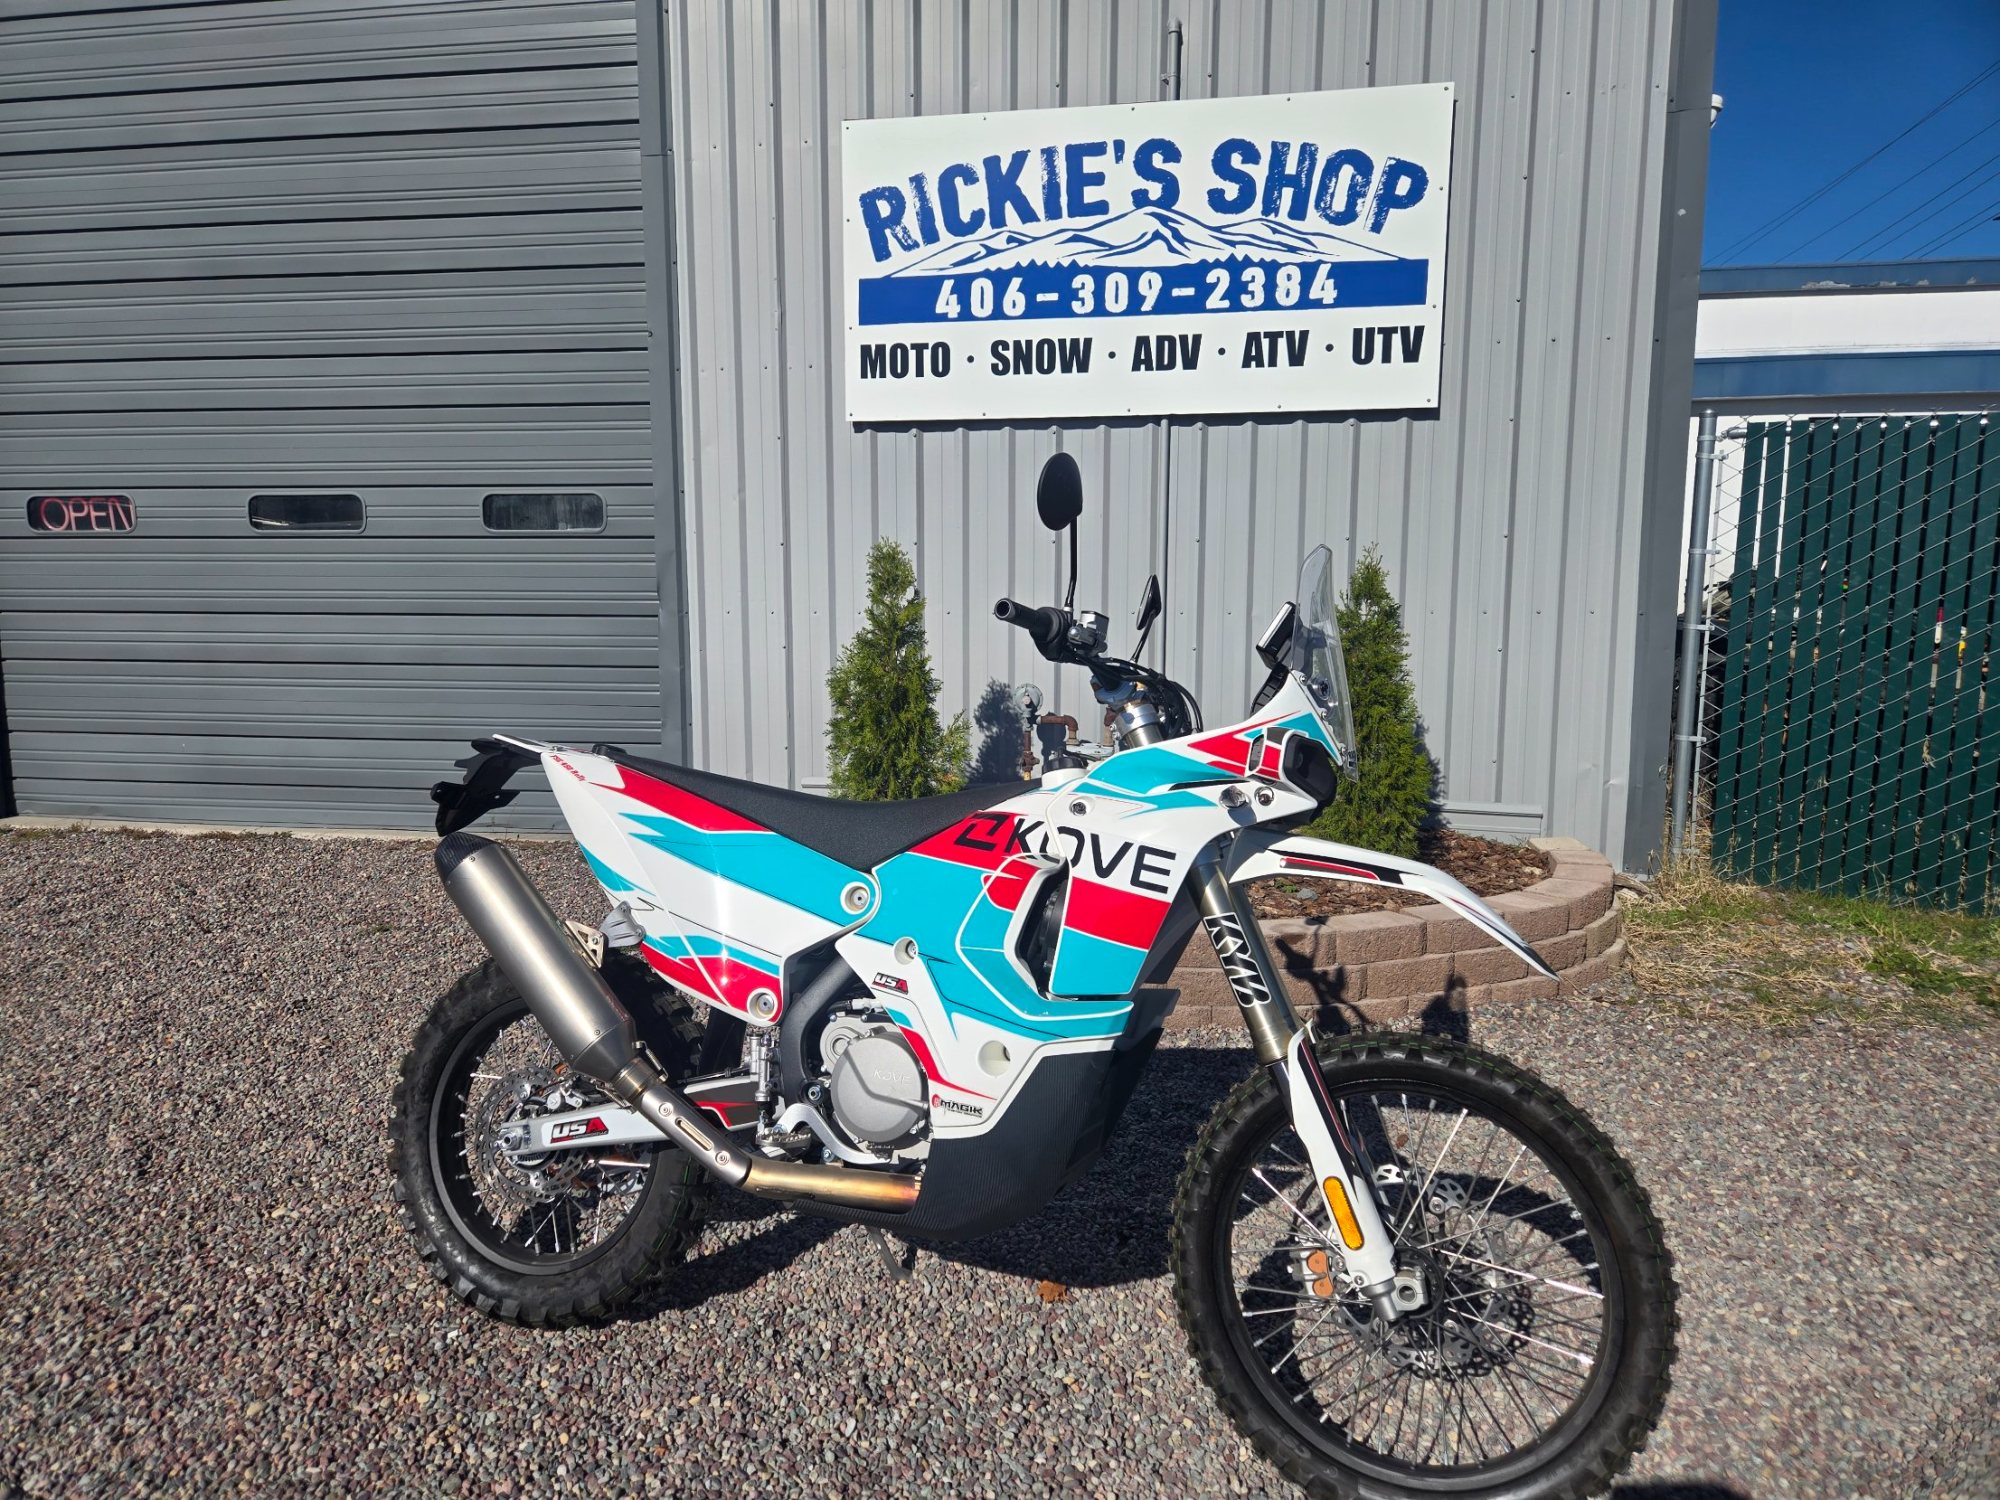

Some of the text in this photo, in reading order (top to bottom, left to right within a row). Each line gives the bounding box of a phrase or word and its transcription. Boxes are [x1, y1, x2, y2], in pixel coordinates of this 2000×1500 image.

[860, 138, 1429, 262] RICKIE'S SHOP
[935, 263, 1338, 319] 406-309-2384
[860, 326, 1426, 379] MOTO SNOW ADV ATV UTV
[40, 497, 134, 531] OPEN
[1004, 817, 1177, 895] KOVE
[873, 972, 908, 992] USA
[1203, 912, 1271, 1007] KYB
[552, 1117, 608, 1139] USA
